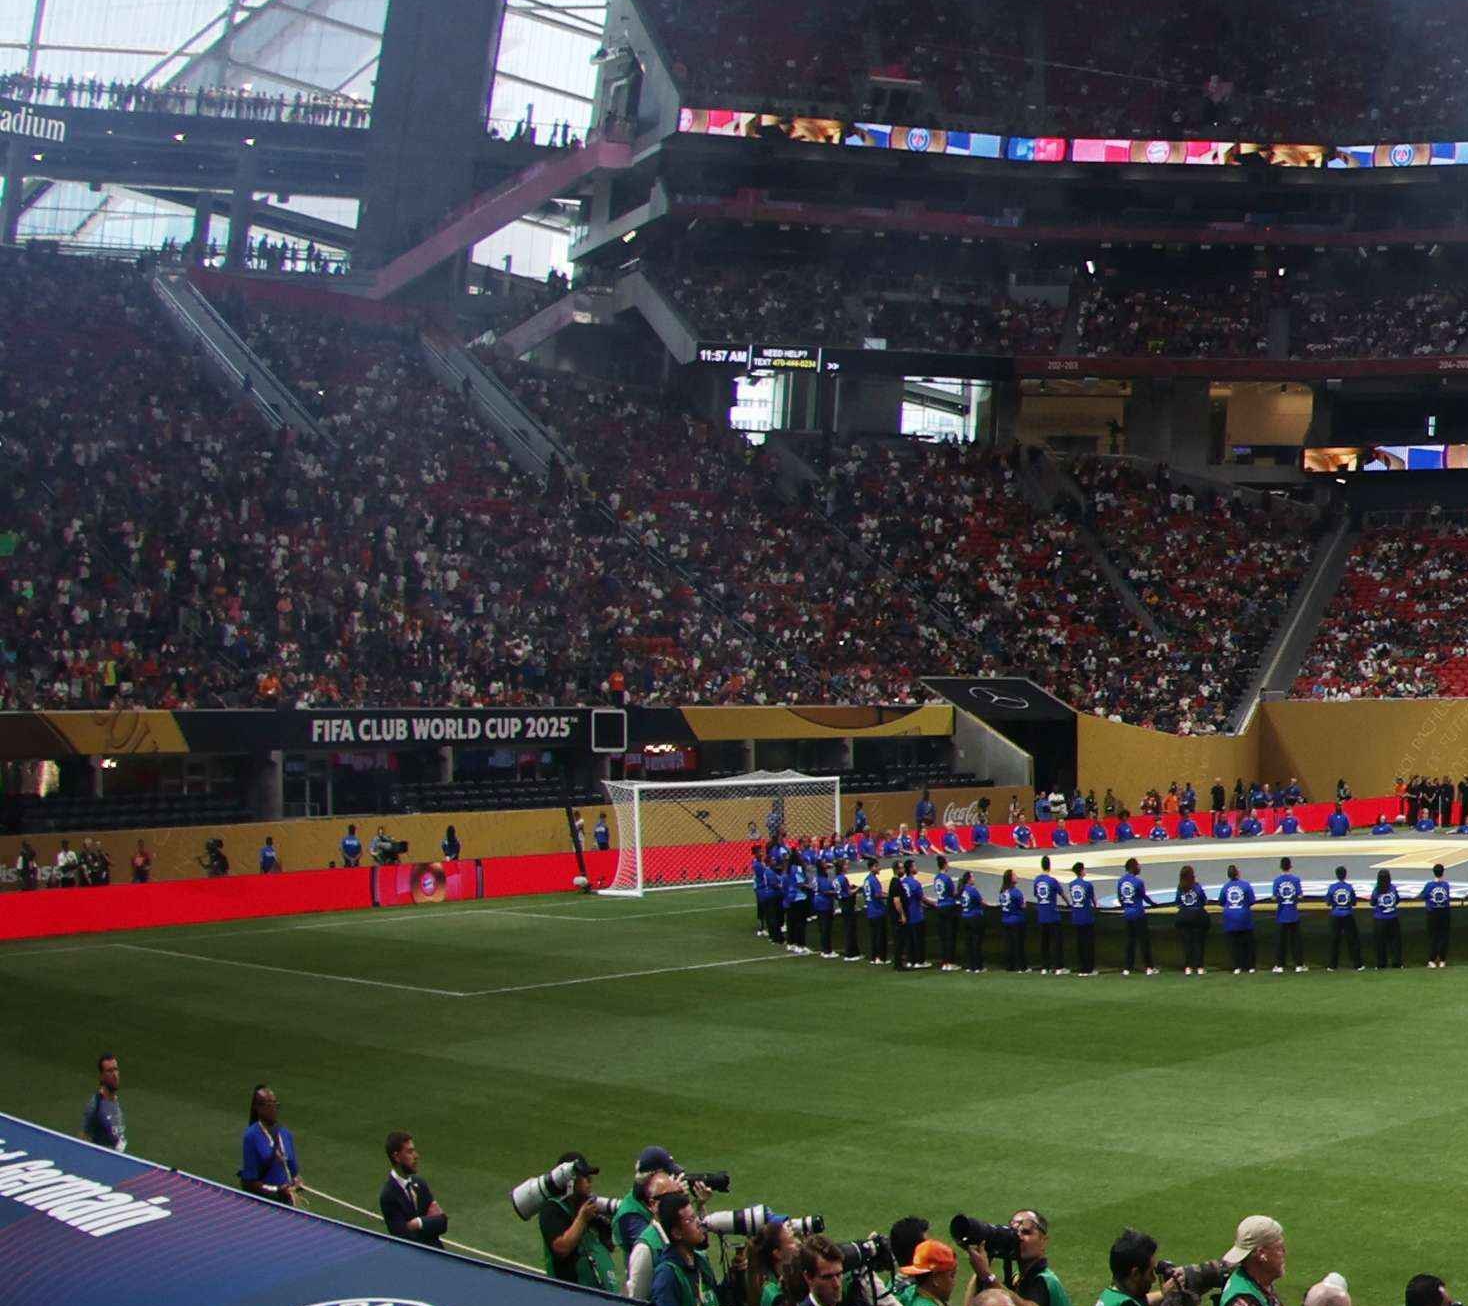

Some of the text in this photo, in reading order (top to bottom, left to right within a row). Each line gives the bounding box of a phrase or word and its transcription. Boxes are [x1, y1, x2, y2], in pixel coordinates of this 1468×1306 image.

[0, 106, 66, 143] adium
[700, 349, 748, 363] 11:57 AM
[311, 718, 355, 743] FIFA
[357, 717, 409, 742] CLUB
[411, 716, 481, 741] WORLD
[484, 716, 523, 740] CUP
